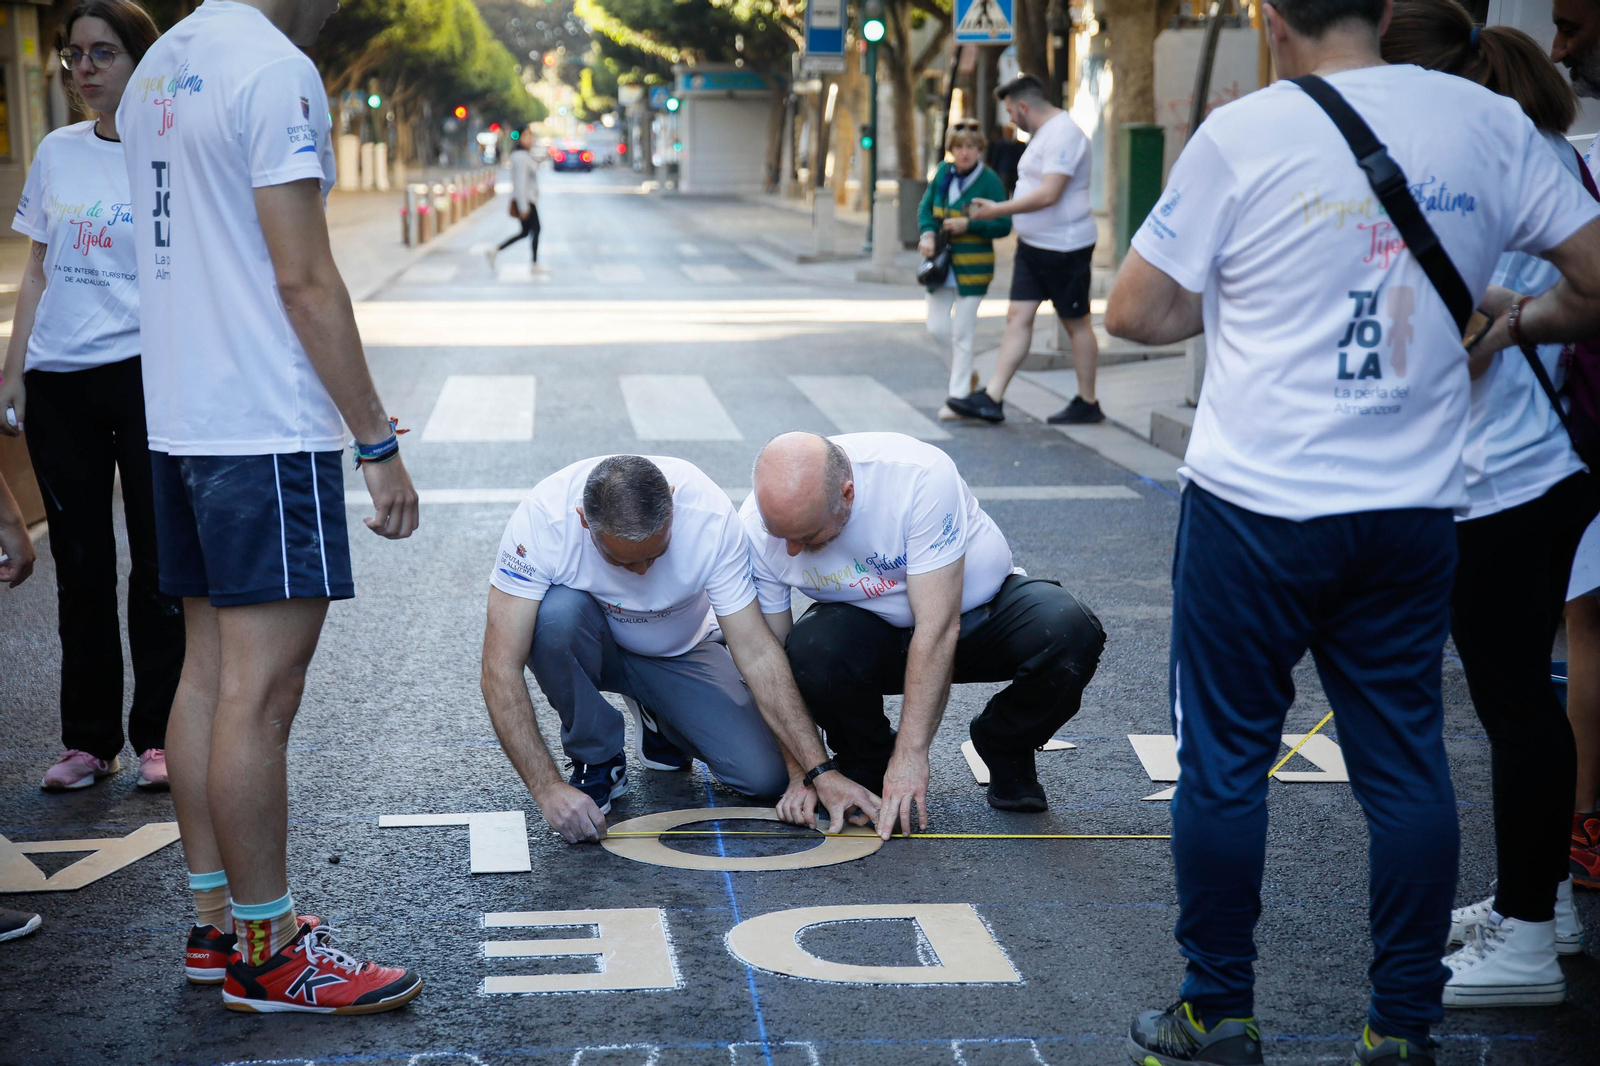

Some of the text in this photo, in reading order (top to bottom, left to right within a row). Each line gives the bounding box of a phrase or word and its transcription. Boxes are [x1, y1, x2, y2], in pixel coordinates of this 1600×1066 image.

[151, 160, 170, 188] T
[86, 200, 104, 218] de
[154, 220, 170, 248] L
[63, 265, 72, 273] DE
[64, 275, 74, 283] DE
[802, 567, 855, 592] Virgen
[853, 558, 870, 574] de
